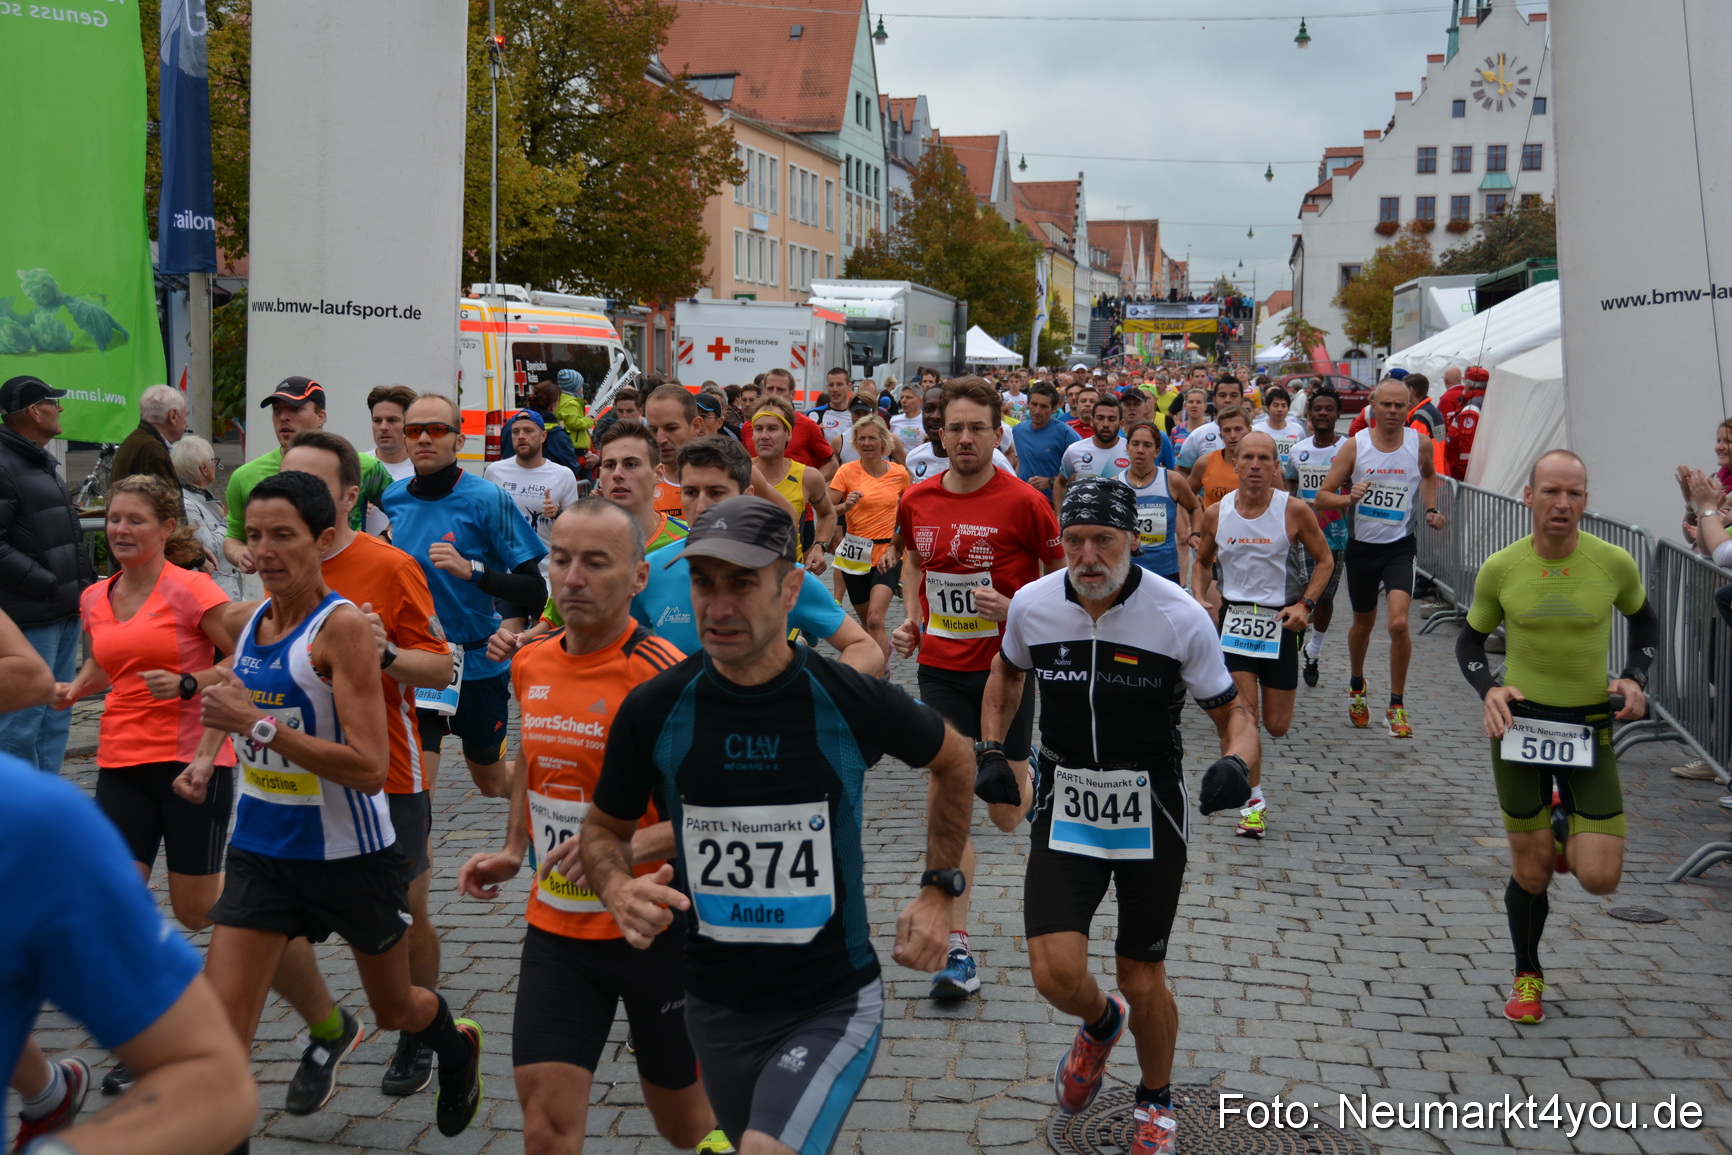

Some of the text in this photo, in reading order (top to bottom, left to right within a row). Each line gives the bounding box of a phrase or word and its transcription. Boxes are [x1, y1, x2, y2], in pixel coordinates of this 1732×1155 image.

[251, 298, 422, 321] www.bmw-laufsport.de
[1154, 322, 1186, 330] START
[735, 337, 779, 346] Bayerisches
[734, 346, 756, 355] Rotes
[733, 355, 756, 364] Kreuz
[1363, 490, 1404, 509] 2657
[1372, 509, 1390, 518] Peter
[957, 529, 989, 538] STADTLAUF
[959, 523, 999, 535] NEUMARKTER
[841, 543, 864, 561] 507
[942, 618, 978, 630] Michael
[1229, 616, 1277, 640] 2552
[1035, 667, 1087, 681] TEAM
[1096, 671, 1162, 688] NALINI
[524, 712, 605, 738] SportScheck
[1537, 728, 1577, 739] Neumarkt
[586, 740, 606, 751] 2009
[1521, 736, 1574, 763] 500
[1056, 770, 1132, 788] PARTL Neumarkt
[1064, 786, 1142, 824] 3044
[686, 817, 803, 834] PARTL Neumarkt
[698, 838, 820, 889] 2374
[730, 903, 785, 924] Andre
